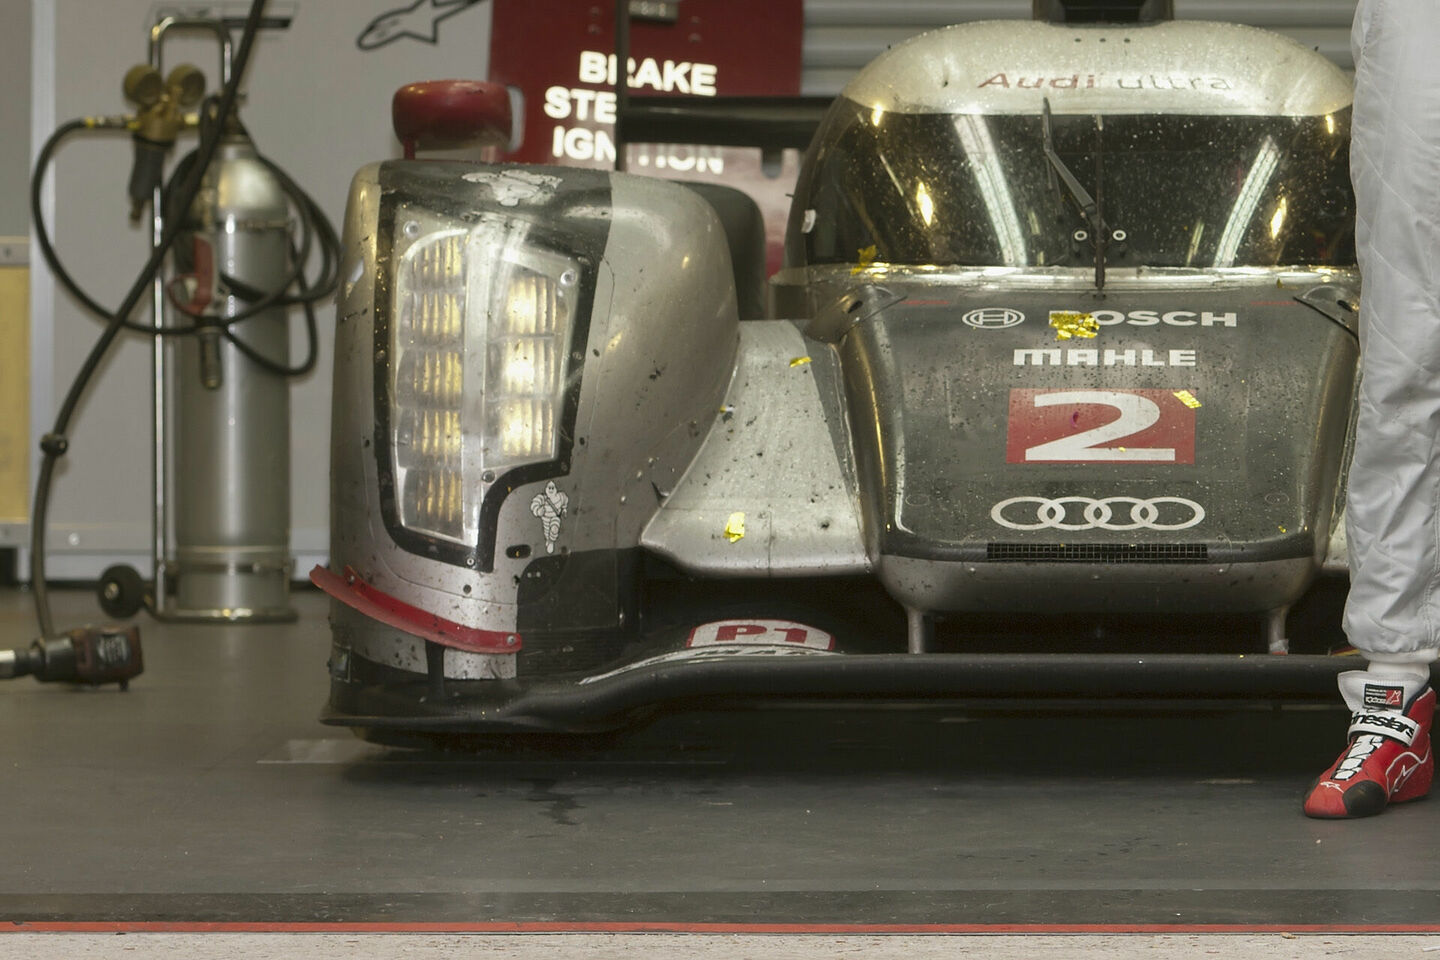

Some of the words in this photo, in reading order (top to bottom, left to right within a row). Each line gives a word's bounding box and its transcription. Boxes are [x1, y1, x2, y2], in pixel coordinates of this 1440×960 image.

[579, 50, 717, 97] BRAKE
[977, 73, 1097, 90] Audi
[1117, 73, 1232, 91] ultra
[553, 125, 724, 175] IGNTION
[1049, 310, 1238, 328] OSCH
[1013, 348, 1196, 367] MAHLE
[1025, 390, 1176, 461] 2
[715, 625, 808, 644] P1
